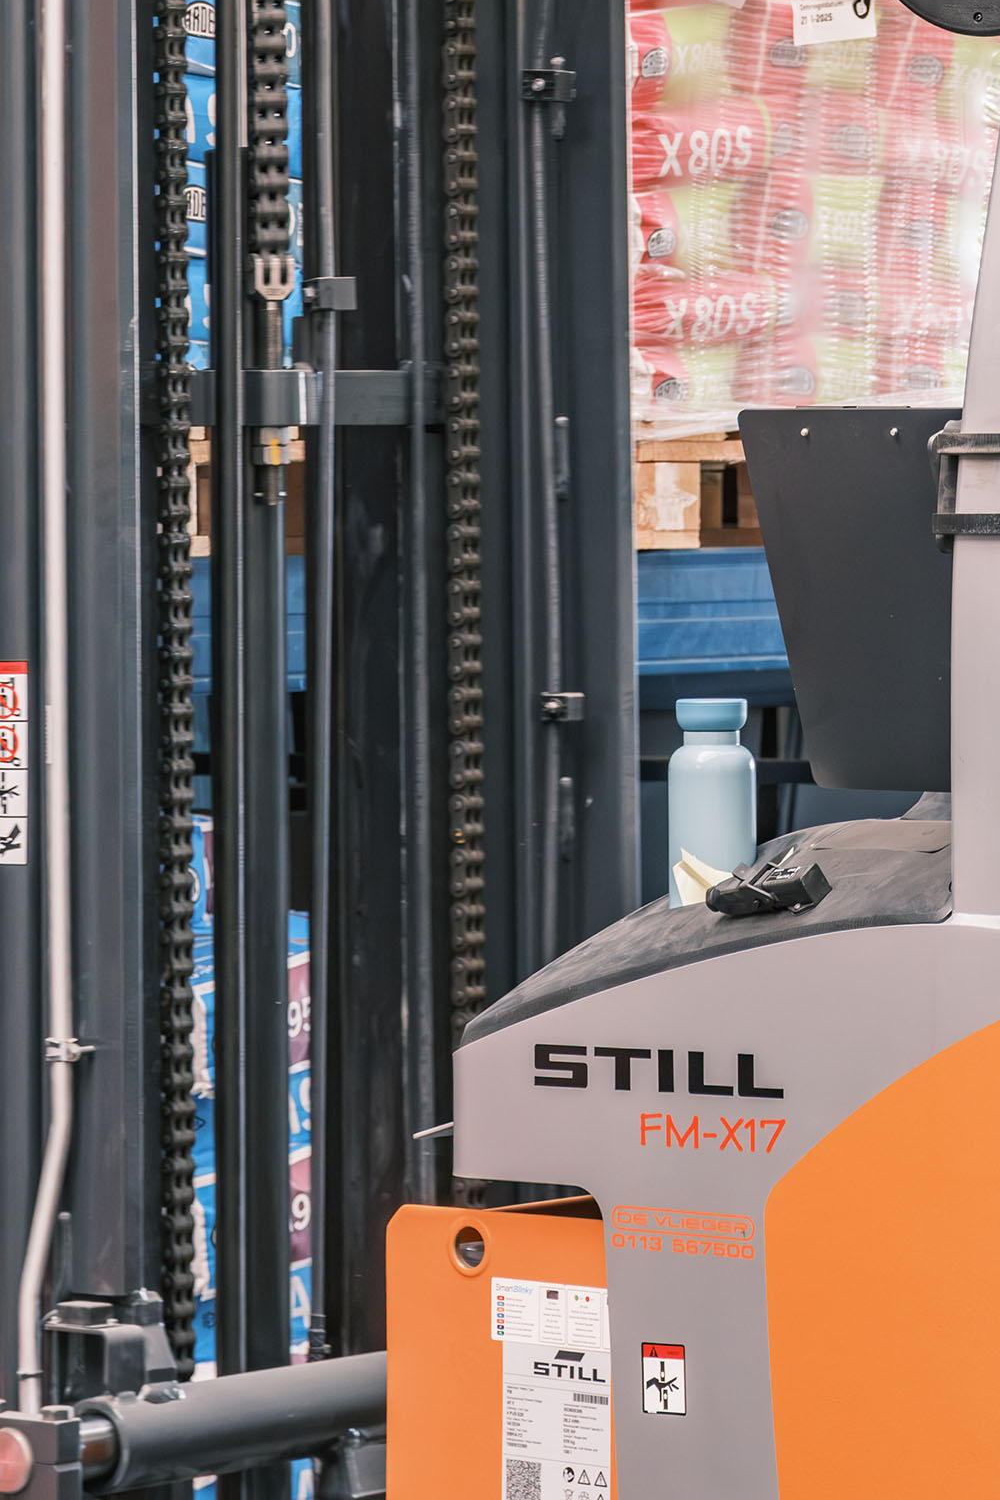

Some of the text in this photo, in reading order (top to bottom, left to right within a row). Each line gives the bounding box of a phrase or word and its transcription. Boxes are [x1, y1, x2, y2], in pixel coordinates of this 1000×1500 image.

[658, 125, 753, 178] X80S
[662, 291, 758, 340] X80S
[534, 1043, 785, 1099] STILL
[640, 1113, 787, 1154] FM-X17
[616, 1210, 750, 1238] DE VLIEGER
[612, 1233, 755, 1260] 0113 567500
[533, 1361, 607, 1384] STILL
